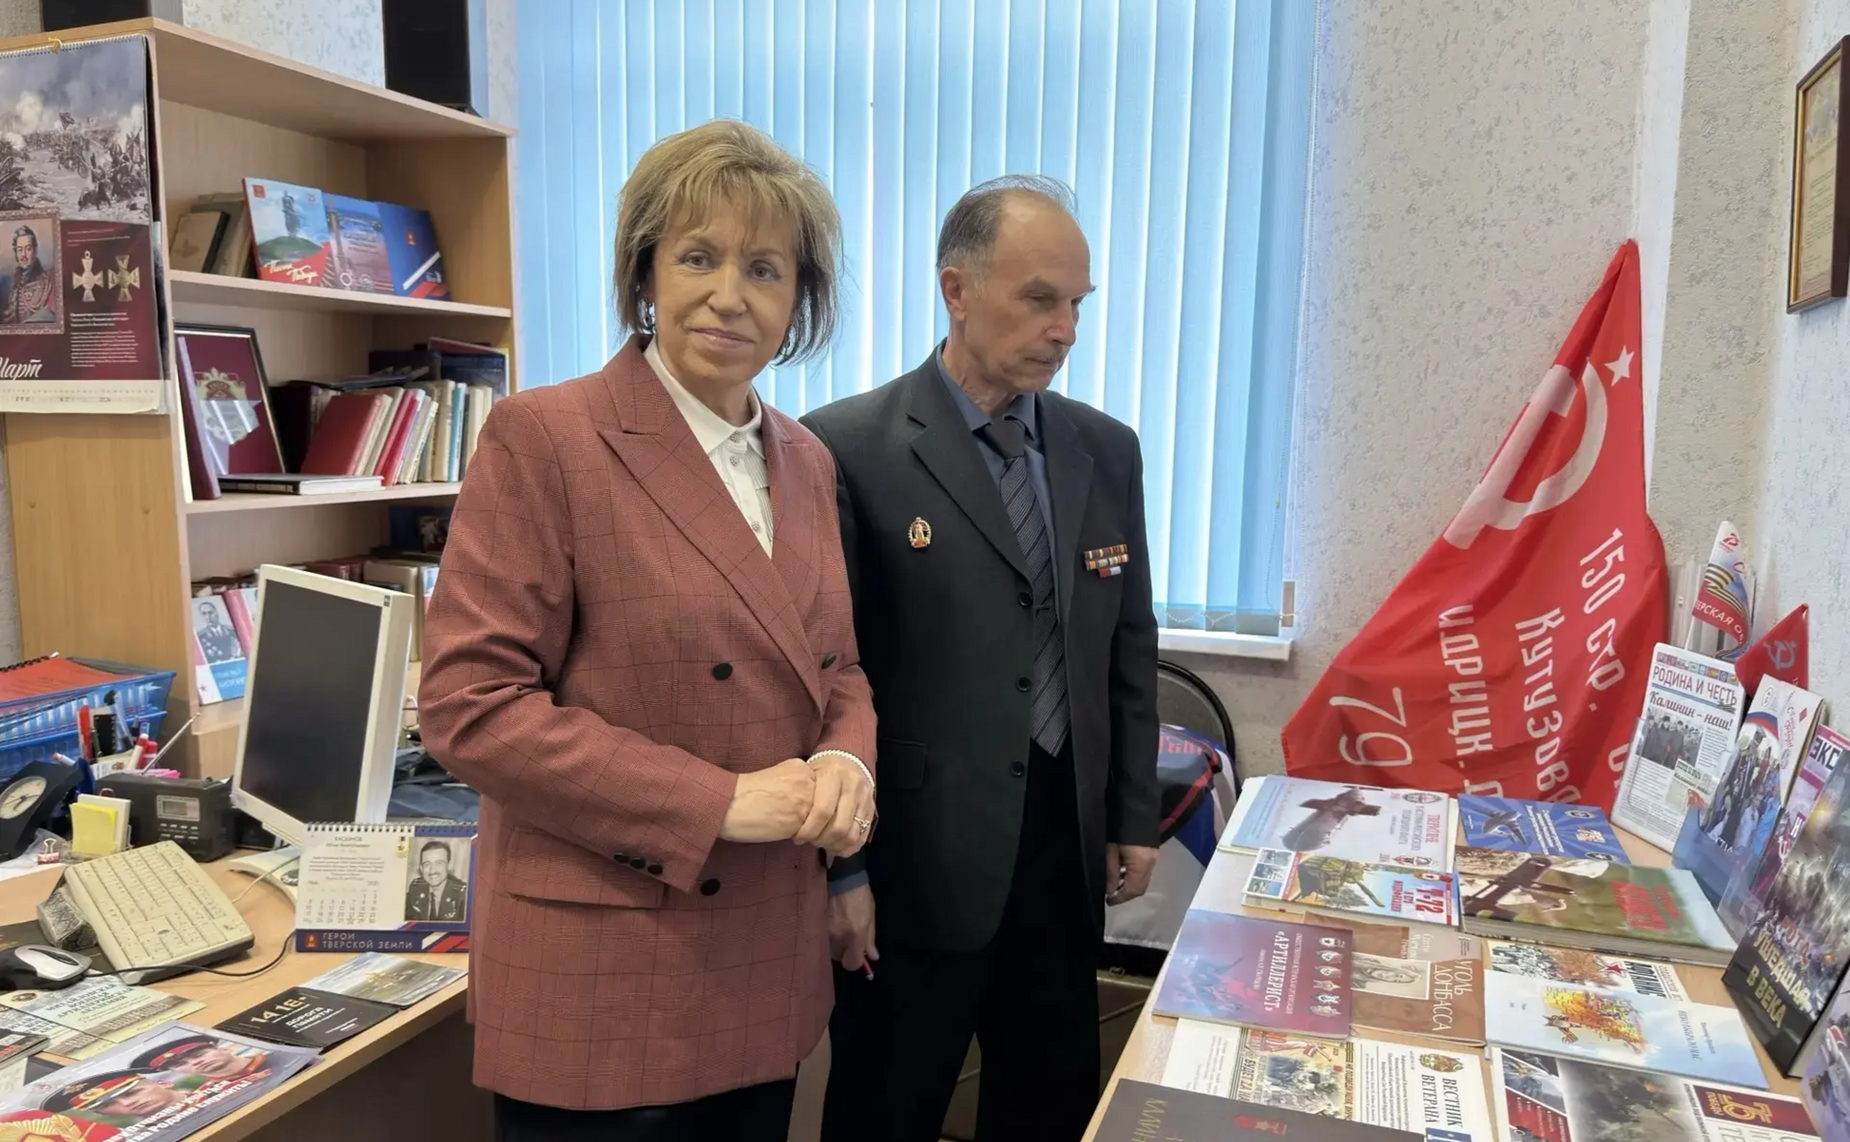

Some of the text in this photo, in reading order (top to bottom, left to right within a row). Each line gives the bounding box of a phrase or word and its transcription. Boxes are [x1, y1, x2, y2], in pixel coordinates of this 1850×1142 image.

[1580, 529, 1625, 614] 150
[1649, 690, 1695, 718] Калинин
[1704, 711, 1734, 731] наш!
[1653, 665, 1737, 707] РОДИНА И ЧЕСТЬ
[322, 932, 355, 940] ГЕРОИ
[322, 939, 413, 949] ТВЕРСКОЙ ЗЕМЛИ
[1263, 931, 1289, 1011] «АРТИЛЛЕРИСТ»
[1454, 961, 1473, 995] УГОЛЬ
[1432, 964, 1453, 1031] ДОНБАССА
[1746, 965, 1787, 1028] В ВЕКА
[1421, 1074, 1440, 1123] ВЕТЕРАНА
[1442, 1078, 1463, 1128] ВЕСТНИК
